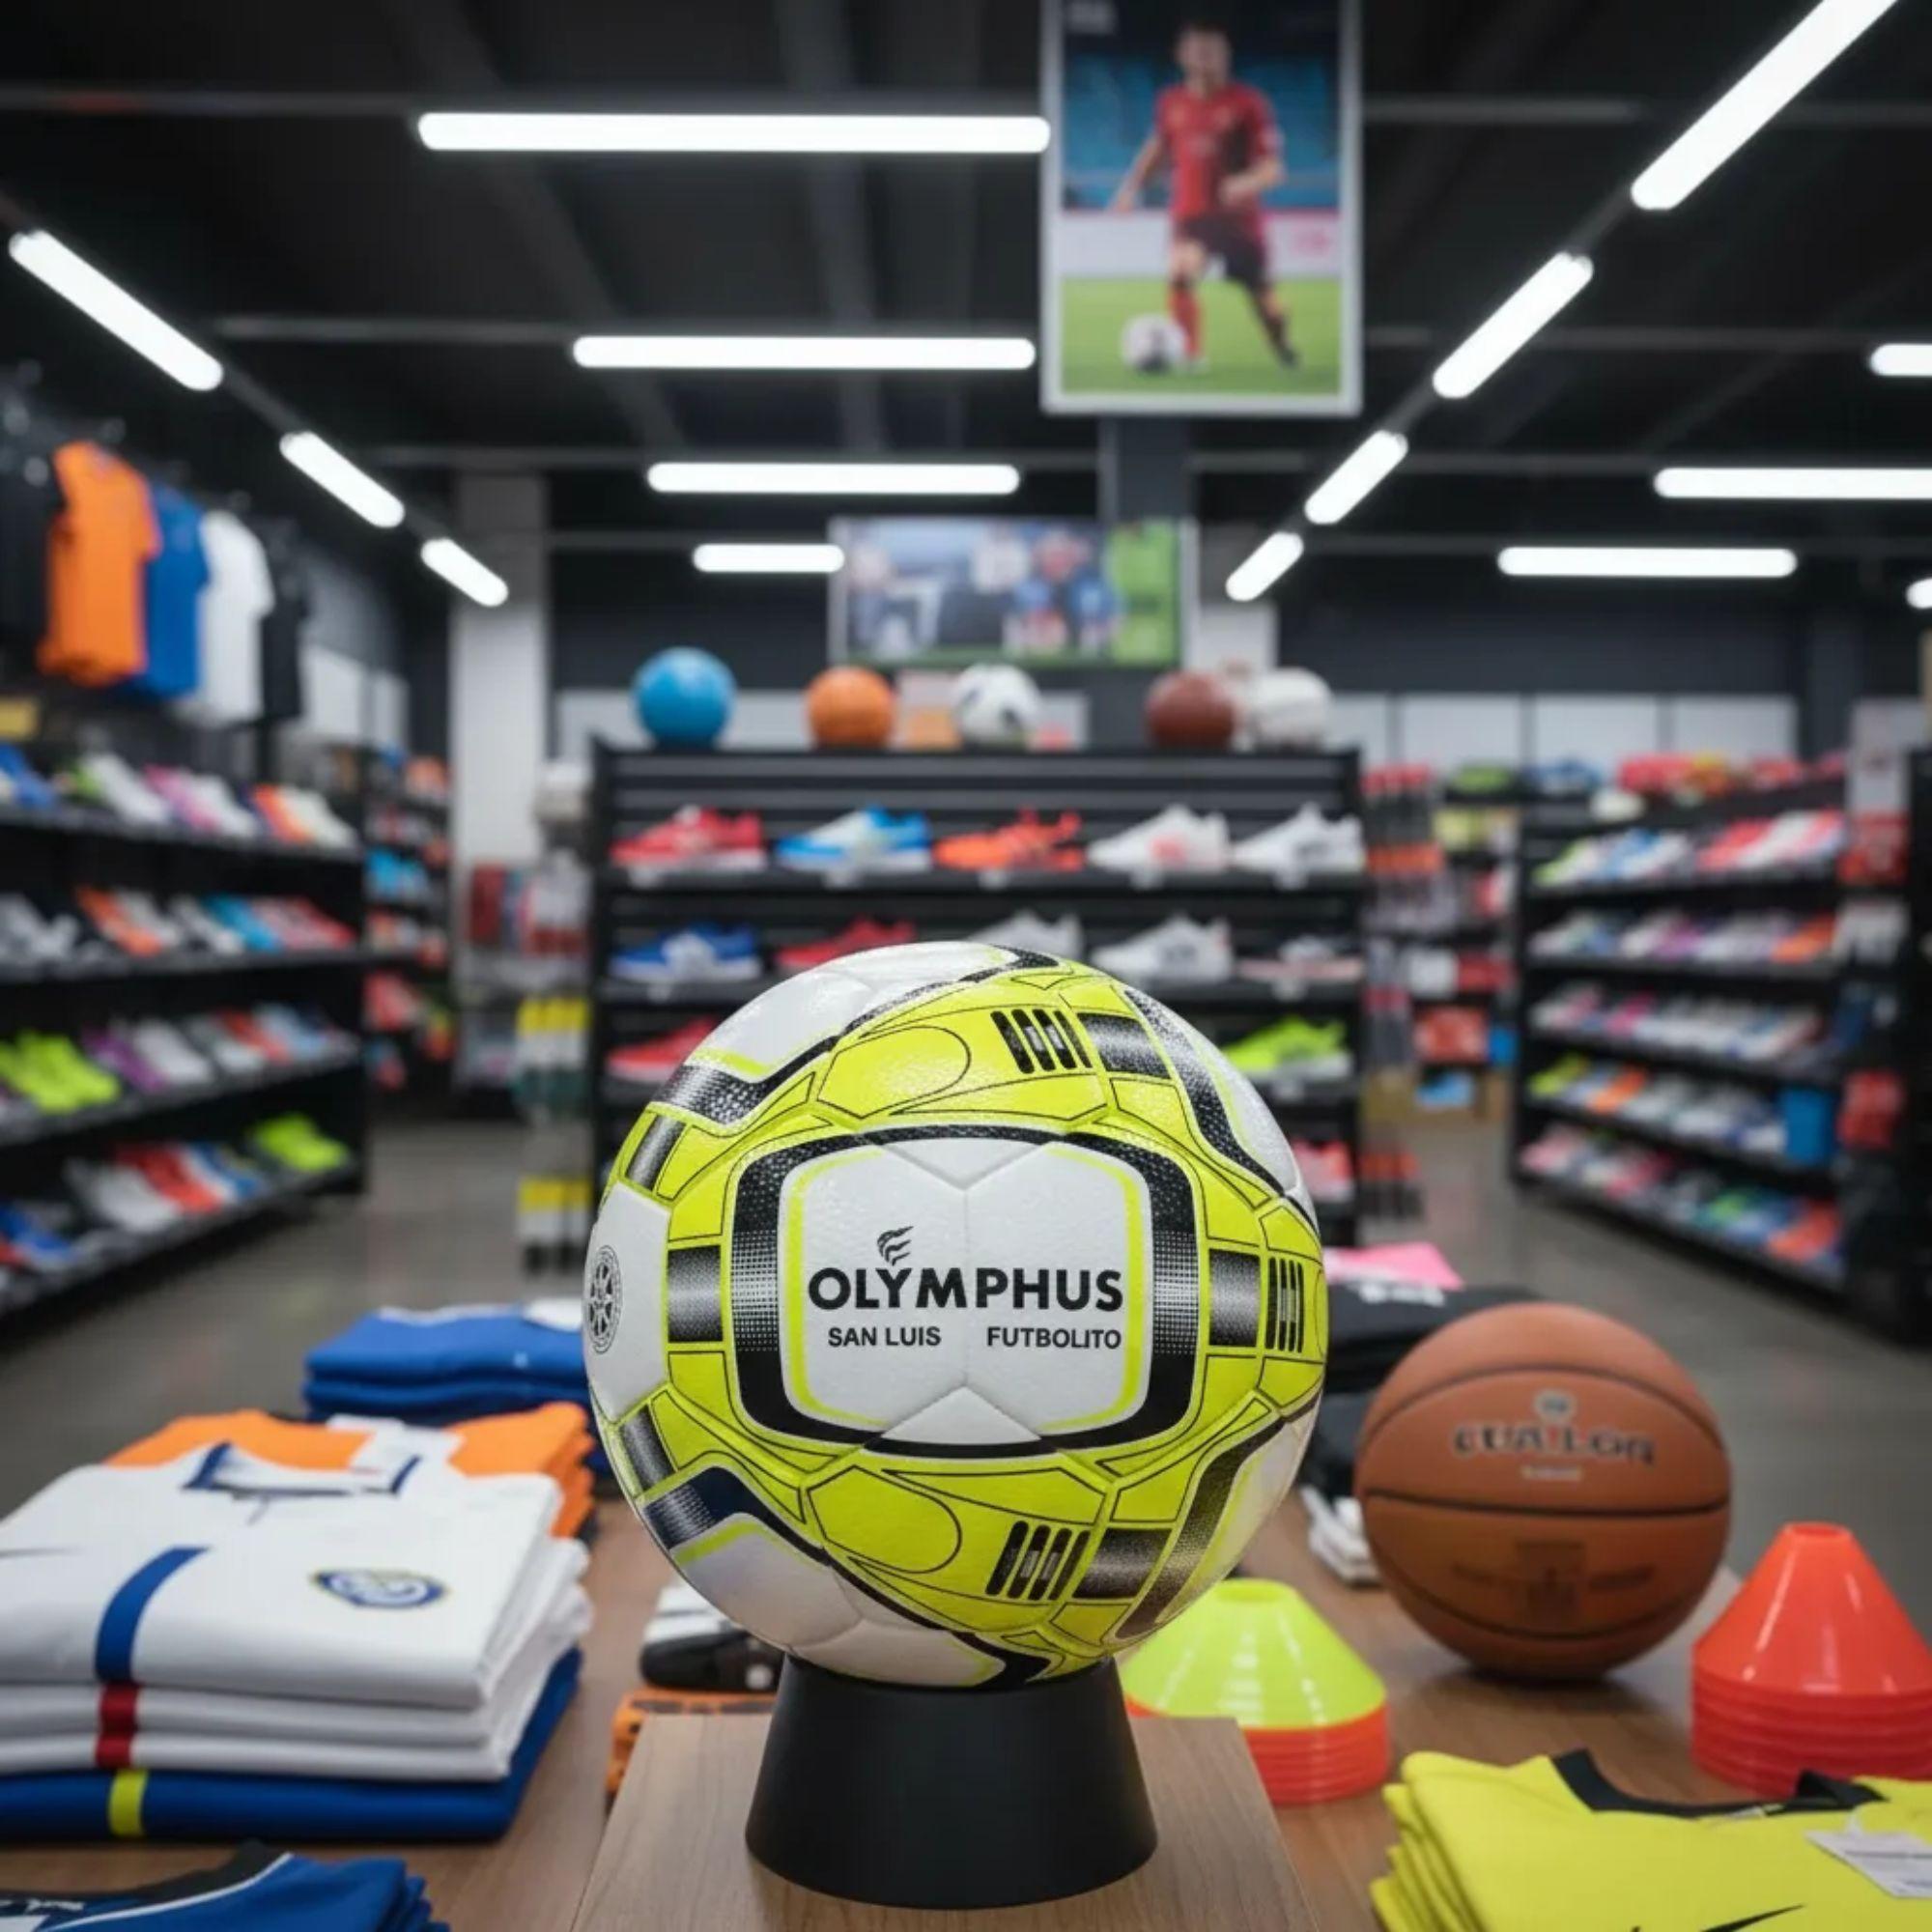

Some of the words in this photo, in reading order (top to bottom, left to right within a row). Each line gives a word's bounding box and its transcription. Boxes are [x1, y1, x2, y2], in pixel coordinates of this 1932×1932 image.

[808, 1267, 1123, 1312] OLYMPHUS
[828, 1326, 877, 1348] SAN
[885, 1325, 942, 1347] LUIS
[987, 1325, 1122, 1350] FUTBOLITO
